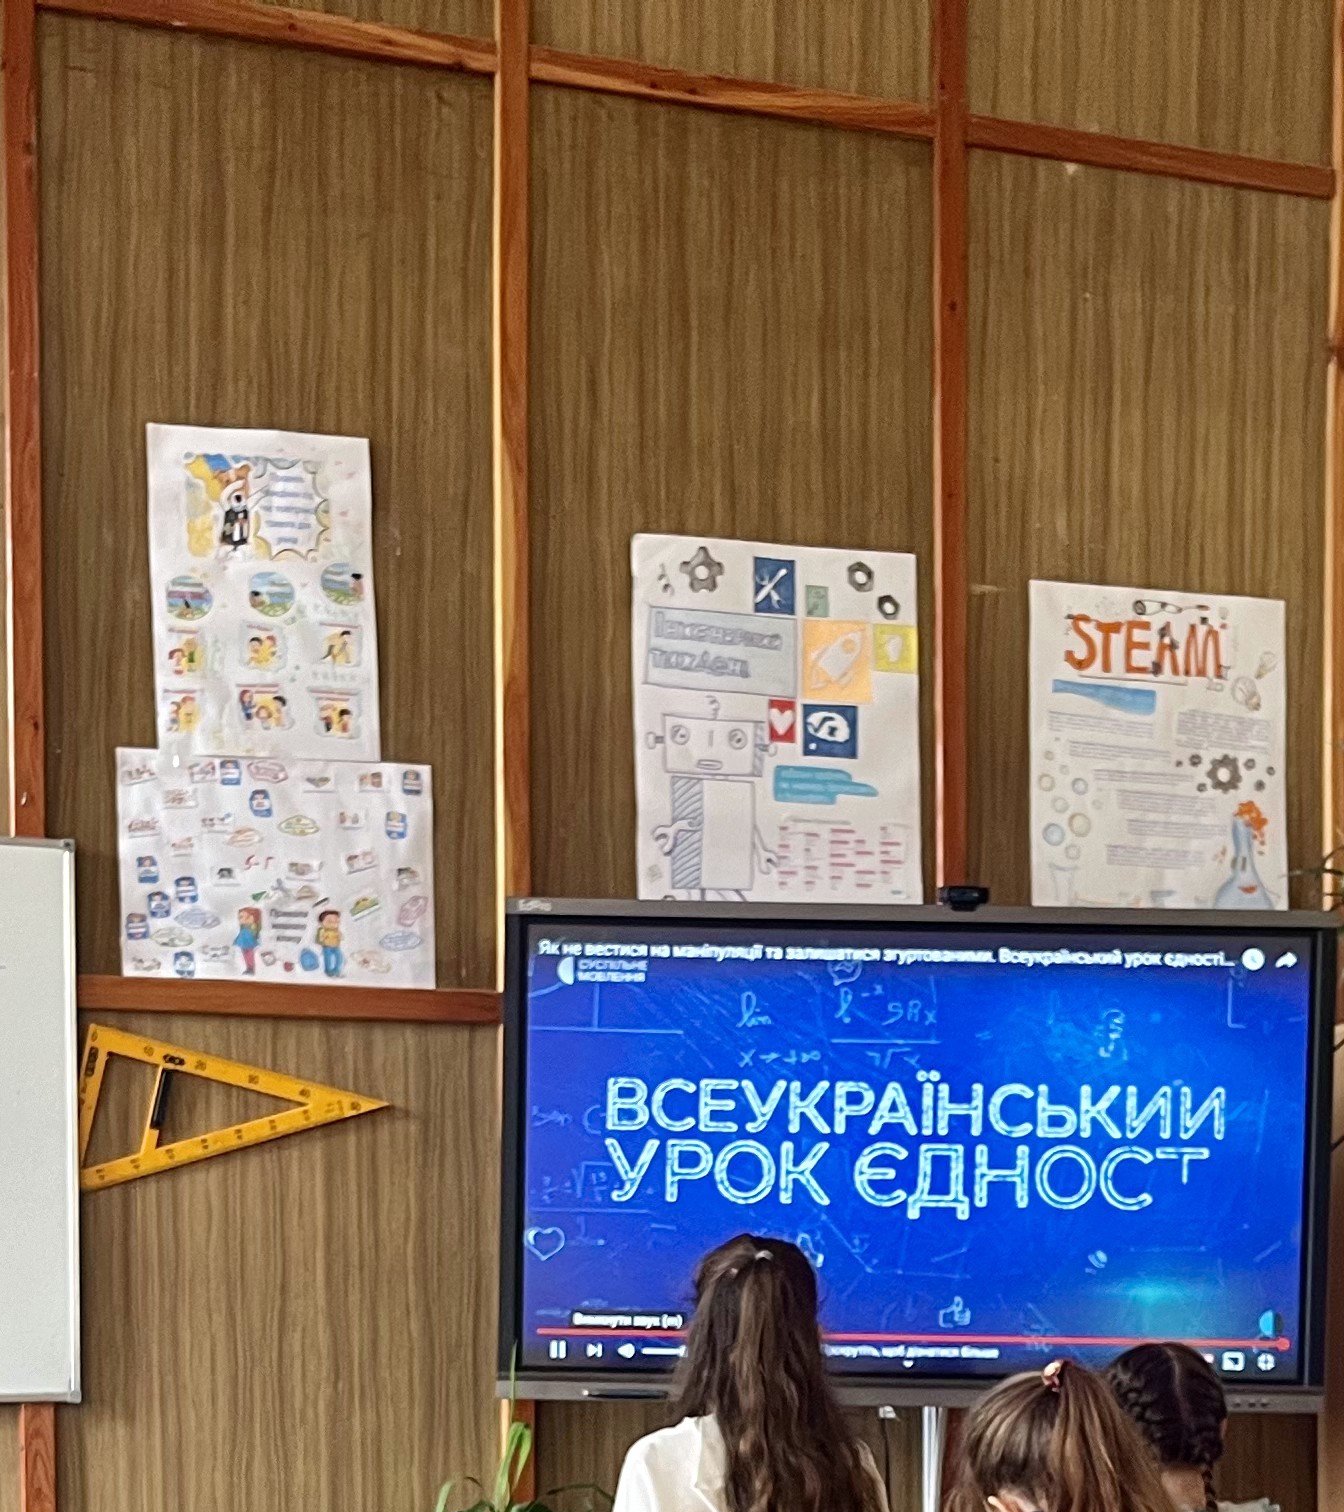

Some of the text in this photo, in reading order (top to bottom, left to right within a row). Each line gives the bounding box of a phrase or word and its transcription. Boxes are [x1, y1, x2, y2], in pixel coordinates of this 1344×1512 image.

[1064, 613, 1222, 679] STEAM
[539, 939, 560, 957] Як
[562, 944, 583, 956] не
[585, 944, 649, 957] вестися
[651, 945, 670, 958] на
[672, 944, 763, 962] маніпуляції
[766, 947, 783, 960] та
[786, 947, 881, 960] залишатися
[1124, 951, 1162, 968] урок
[604, 1136, 831, 1206] УРОК
